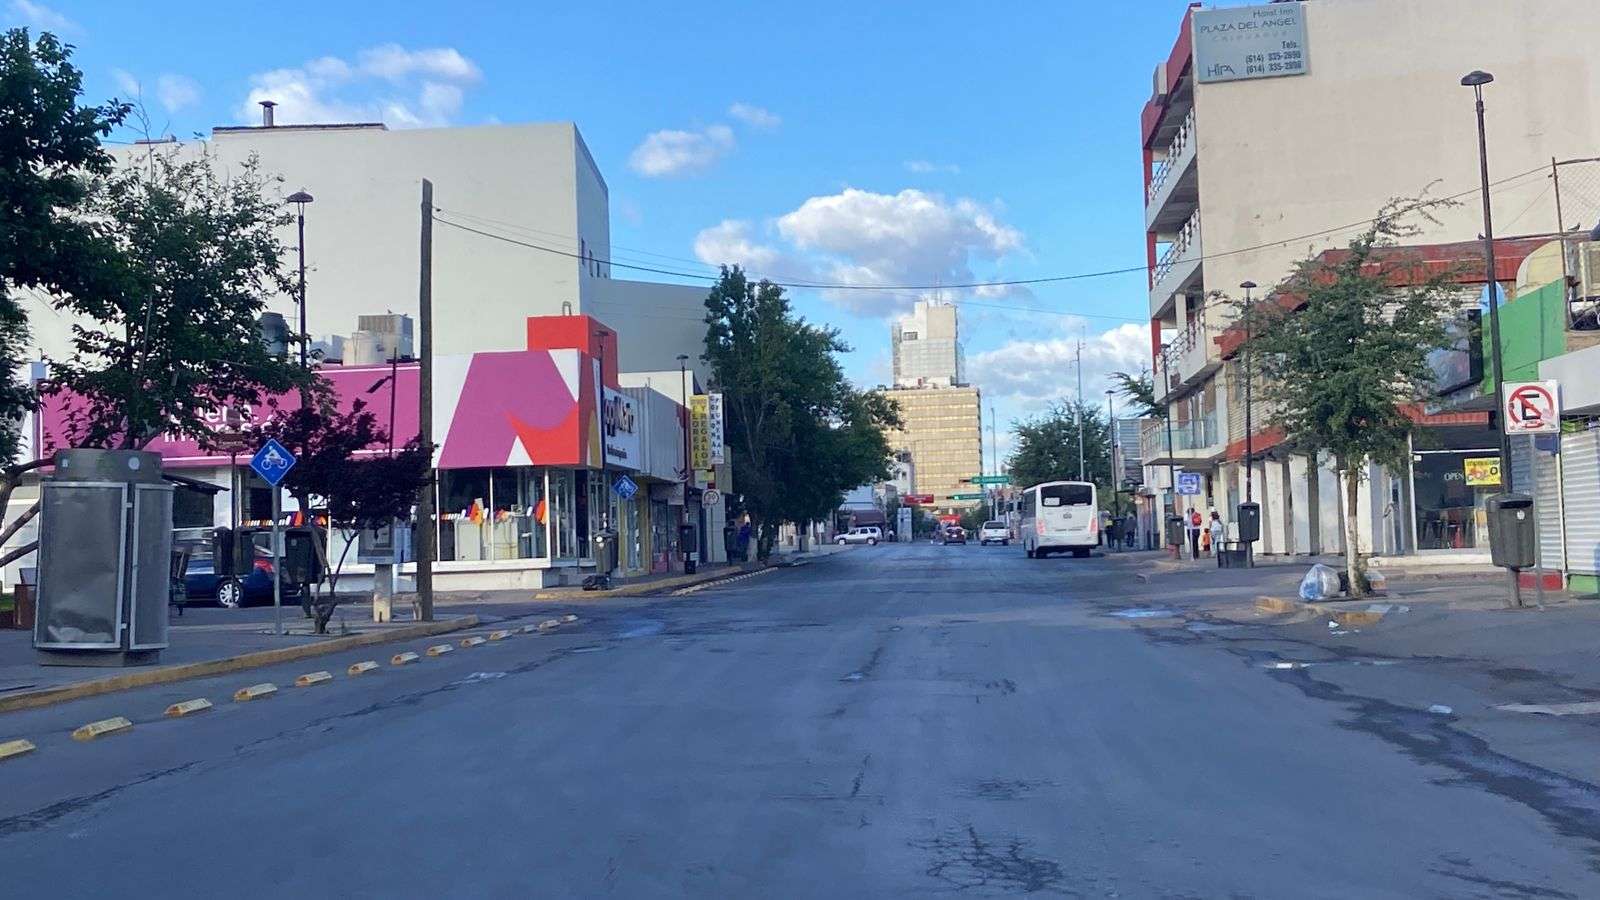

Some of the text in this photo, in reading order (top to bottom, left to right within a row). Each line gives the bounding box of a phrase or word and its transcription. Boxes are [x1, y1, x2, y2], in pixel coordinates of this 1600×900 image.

[1200, 17, 1297, 34] PLAZA DEL ANGEL
[1246, 64, 1265, 75] (614)
[1443, 471, 1465, 481] OPEN
